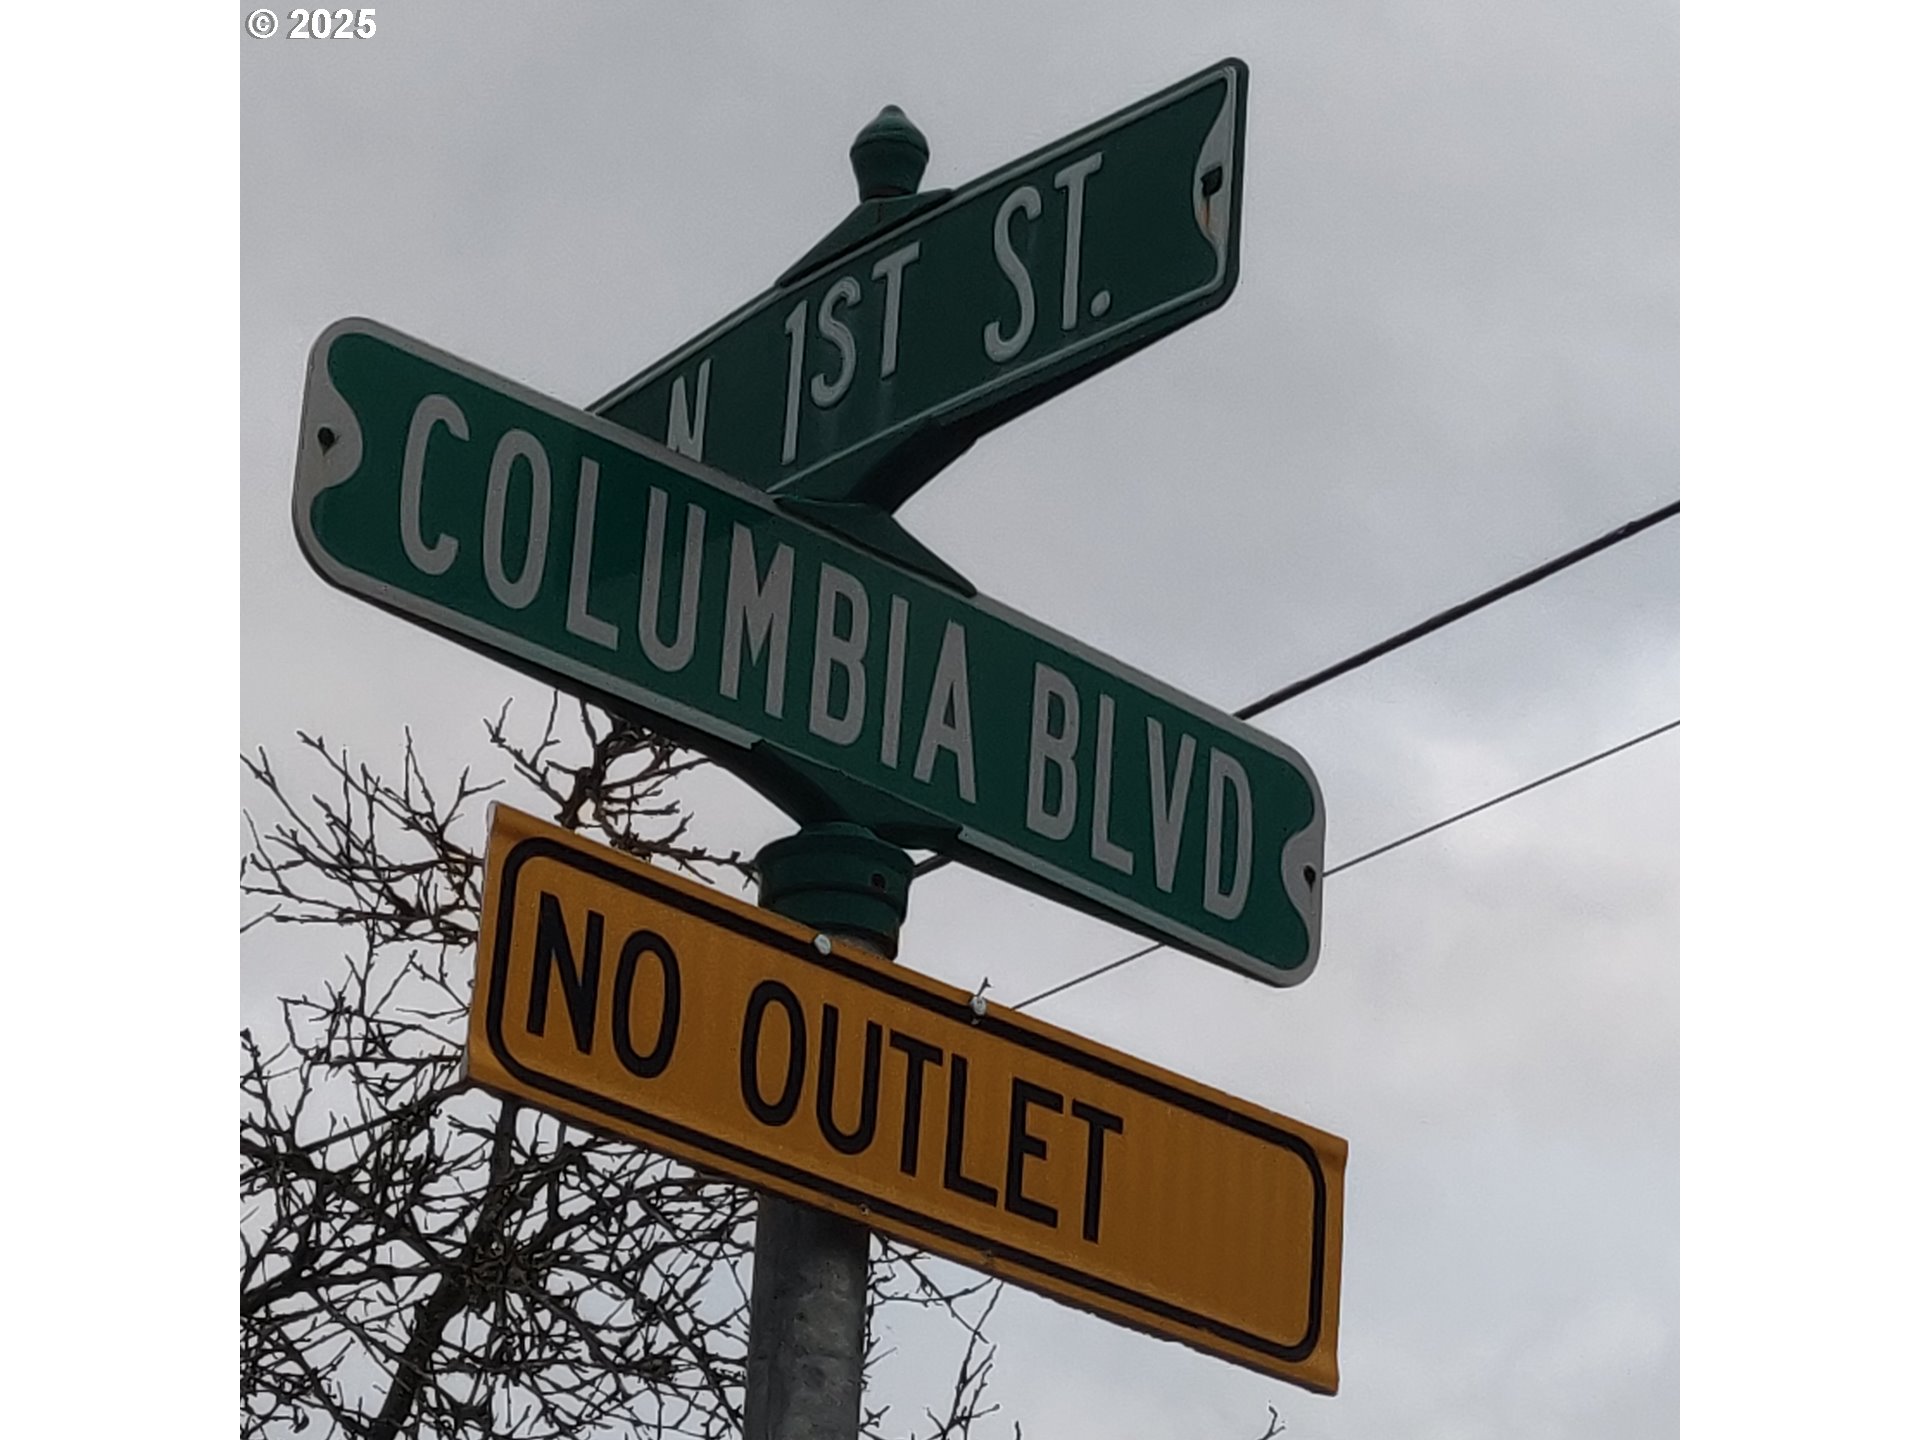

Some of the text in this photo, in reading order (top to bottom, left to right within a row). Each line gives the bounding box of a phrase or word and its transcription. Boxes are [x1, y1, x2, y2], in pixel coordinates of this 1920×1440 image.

[667, 152, 1110, 465] N 1ST ST.
[401, 393, 1253, 920] COLUMBIA BLVD
[526, 890, 1124, 1245] NO OUTLET
